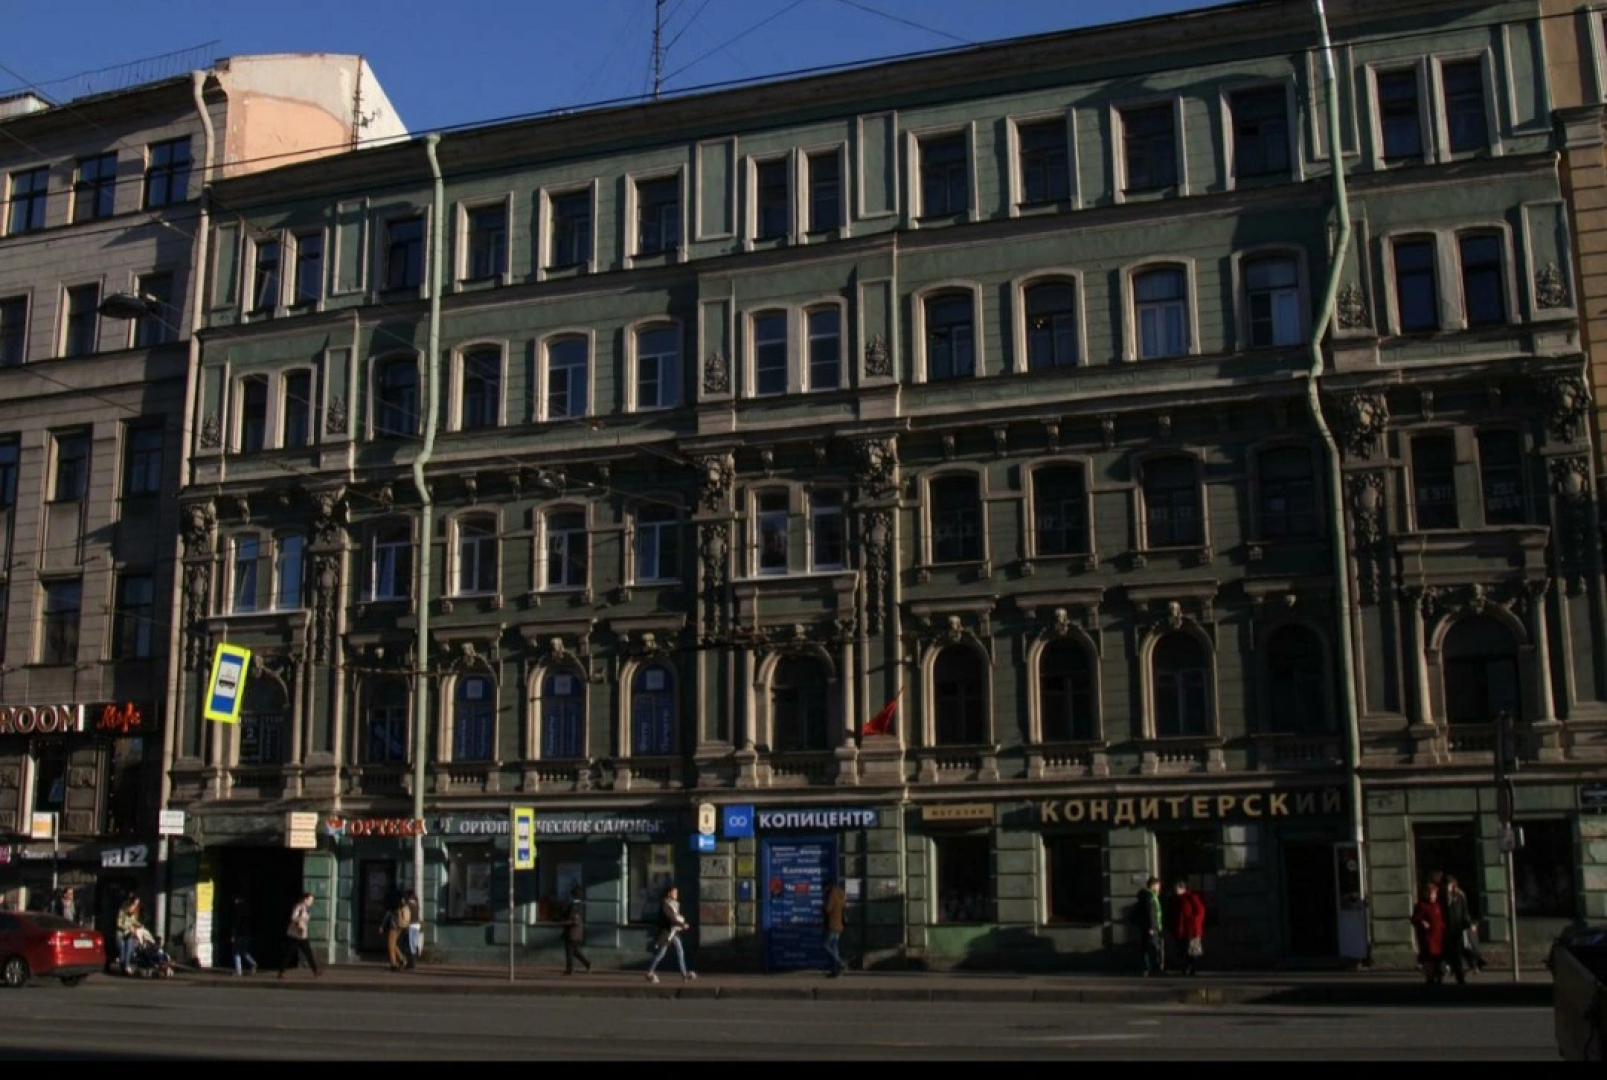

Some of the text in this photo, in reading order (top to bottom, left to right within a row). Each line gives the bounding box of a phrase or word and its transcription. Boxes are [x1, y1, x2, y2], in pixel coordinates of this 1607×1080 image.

[1040, 789, 1342, 825] КОНДИТЕРСКИЙ
[459, 819, 592, 835] ОРТОПЧЕСКИЕ
[594, 818, 660, 834] САЛОНЫ
[758, 811, 875, 829] КОПИЦЕНТР
[101, 845, 149, 868] TELE2
